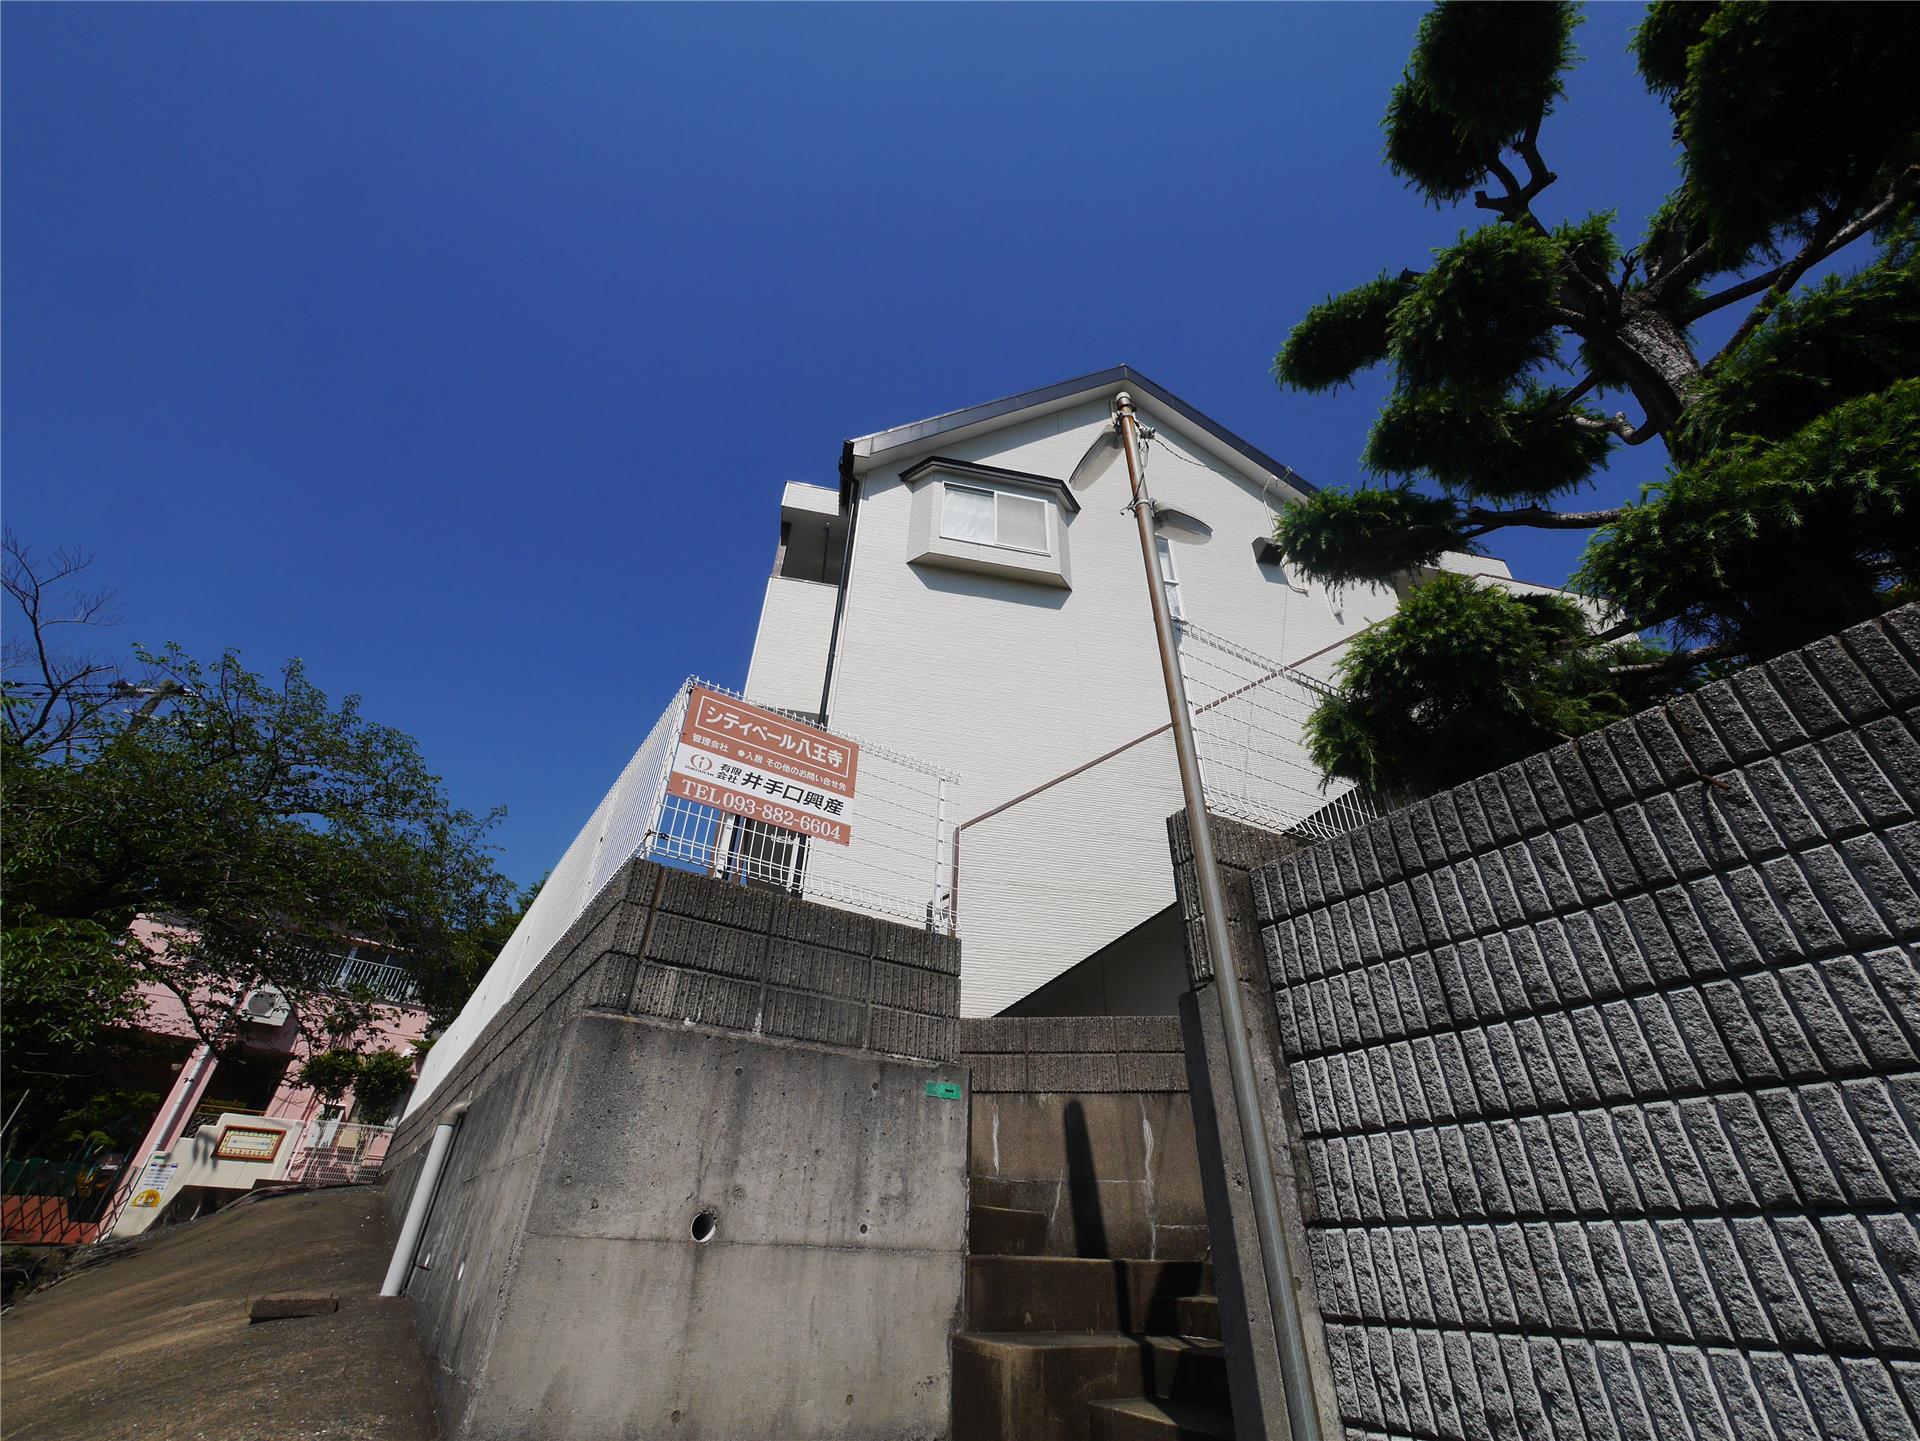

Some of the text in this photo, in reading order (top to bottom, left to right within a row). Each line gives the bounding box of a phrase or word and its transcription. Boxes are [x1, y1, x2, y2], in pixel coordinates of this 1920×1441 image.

[692, 733, 729, 753] 管理会社
[766, 758, 847, 791] その他のお問い合せ先
[706, 706, 843, 768] シティベール八王寺
[716, 772, 737, 784] 会社
[720, 763, 742, 776] 有限
[741, 771, 844, 816] 井手口興産
[682, 779, 840, 840] TEL 093-882-6604
